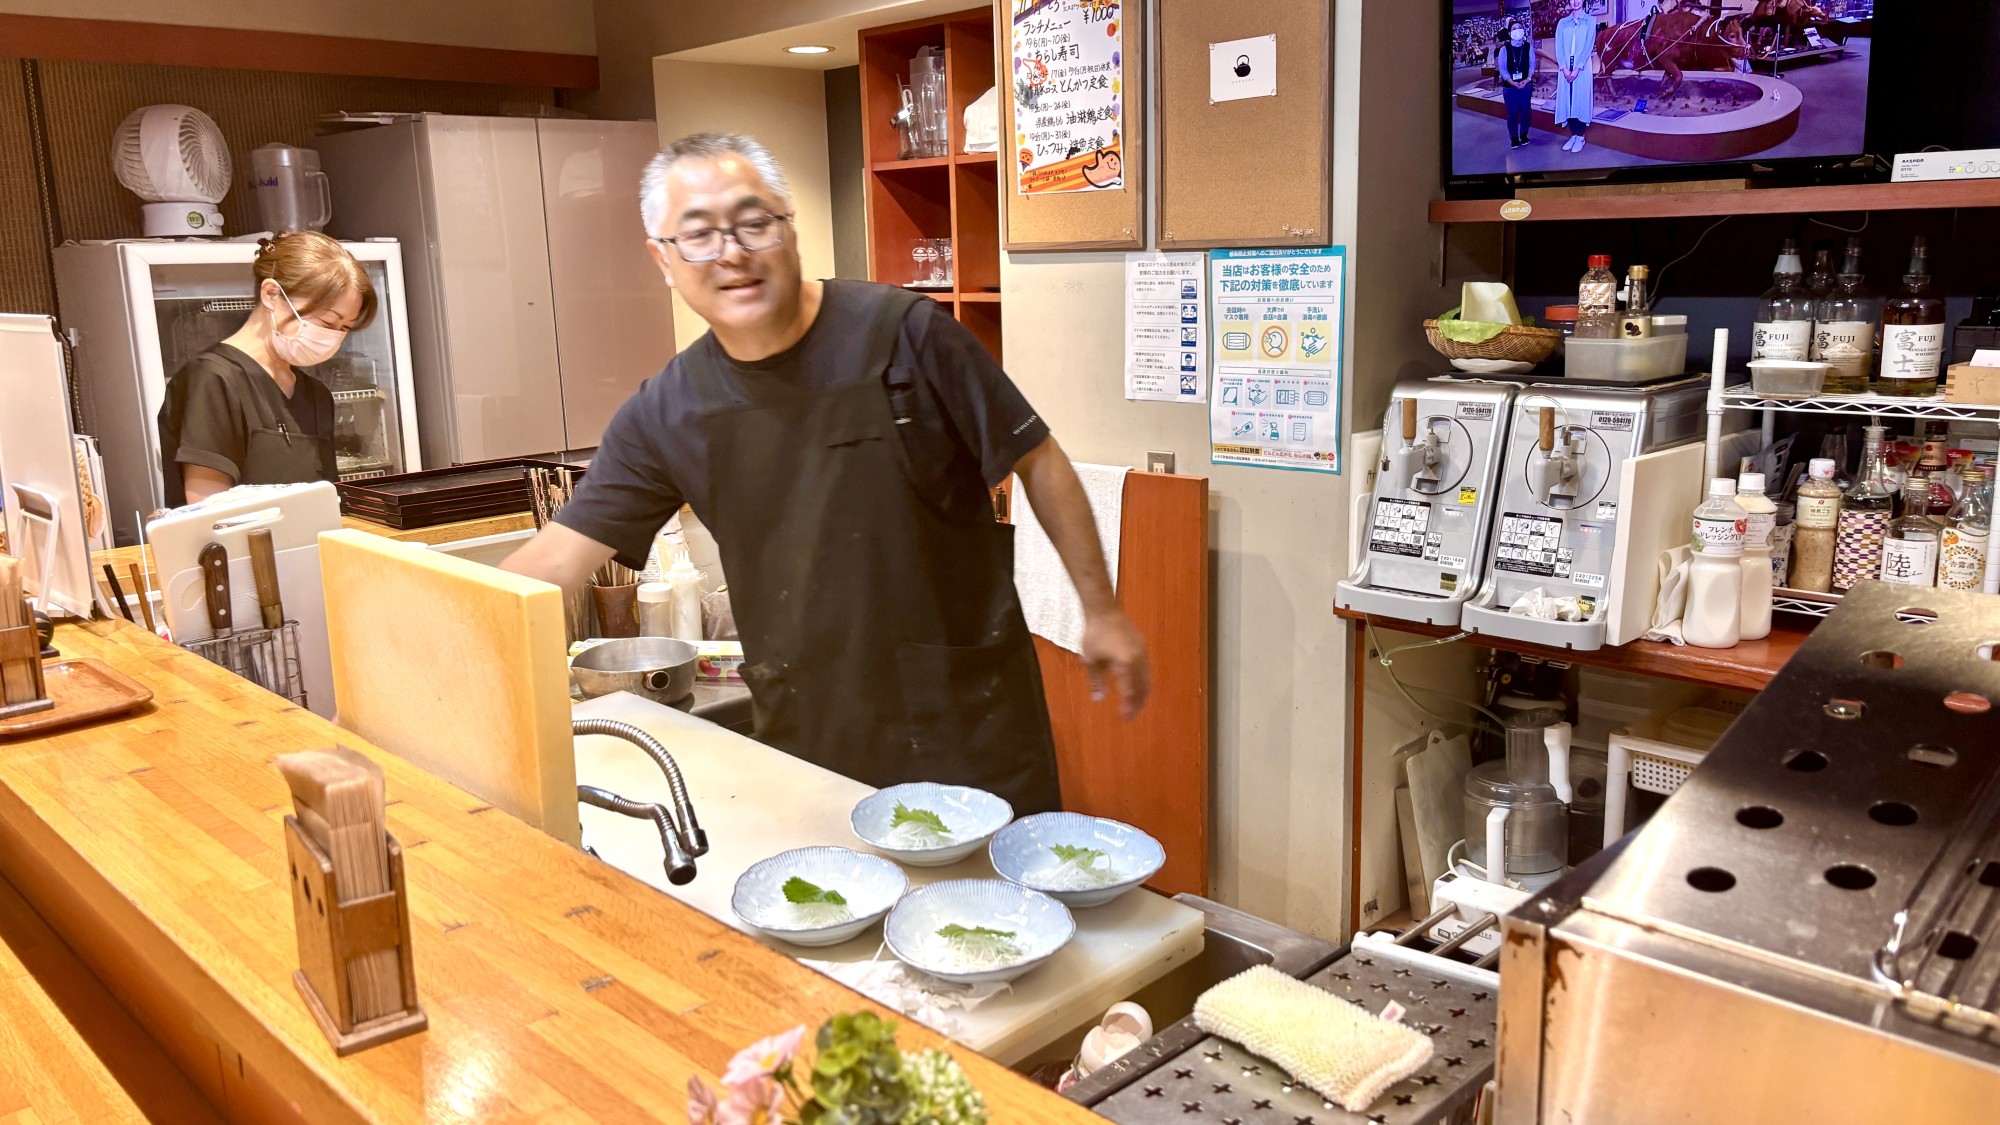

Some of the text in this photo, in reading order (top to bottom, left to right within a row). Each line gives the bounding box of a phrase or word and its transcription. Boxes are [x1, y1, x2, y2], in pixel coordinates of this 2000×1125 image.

[1023, 18, 1071, 36] ランチメニュー
[1035, 43, 1080, 63] ちらし寿司
[1059, 74, 1109, 93] とんかつ定食
[1503, 206, 1530, 214] JASRAC
[1222, 263, 1331, 277] 当店はお客様の安全のため
[1219, 279, 1334, 293] 下記の対策を徹底しています
[1266, 306, 1285, 314] 大声での
[1306, 306, 1323, 314] 手洗い
[1223, 313, 1249, 321] マスク着用
[1768, 333, 1790, 341] FUJI
[1832, 335, 1856, 344] FUJI
[1918, 335, 1936, 343] FUJI
[1893, 329, 1917, 373] 富士
[1885, 552, 1911, 578] 陸
